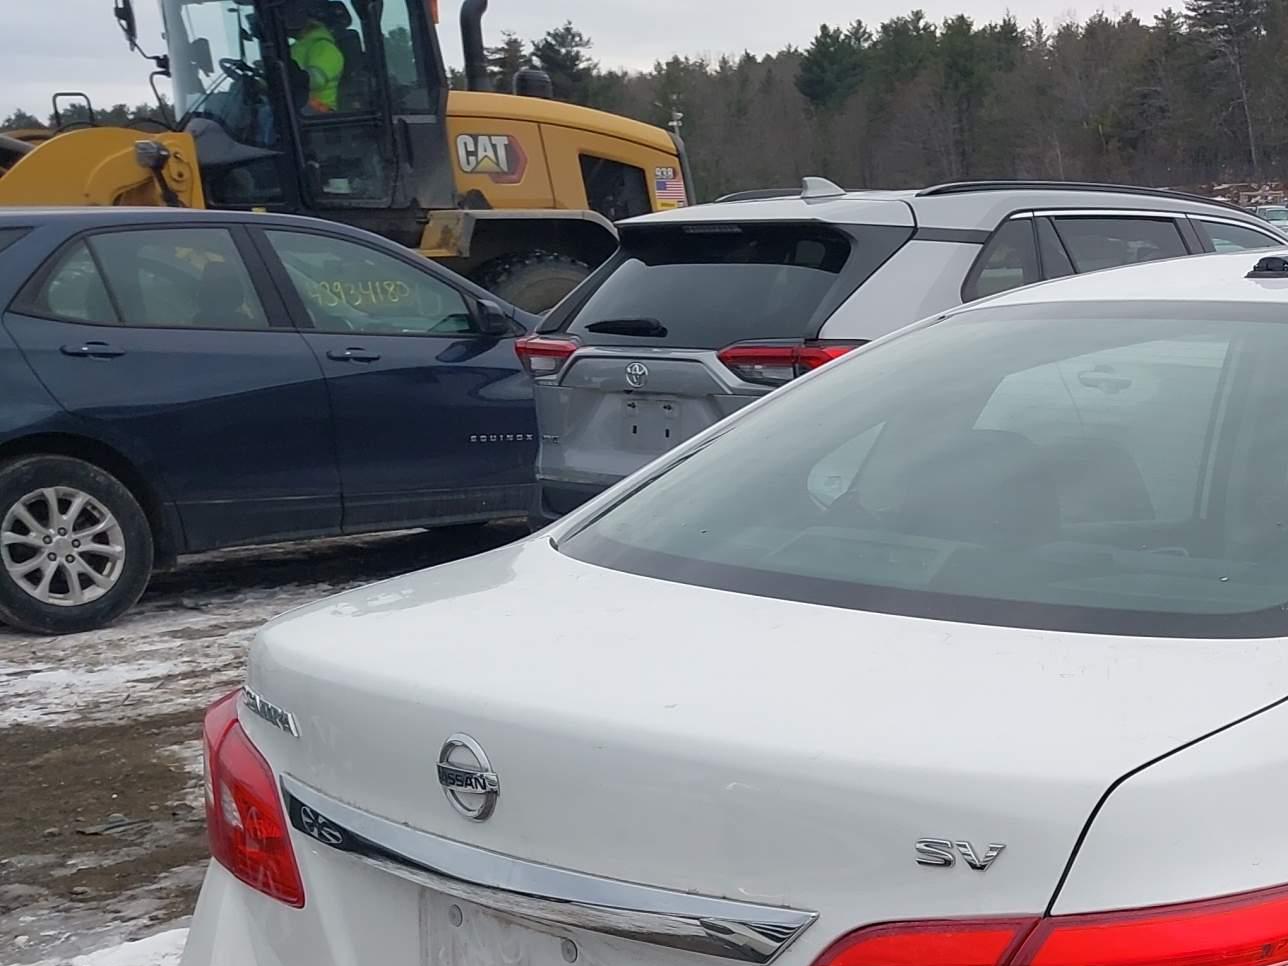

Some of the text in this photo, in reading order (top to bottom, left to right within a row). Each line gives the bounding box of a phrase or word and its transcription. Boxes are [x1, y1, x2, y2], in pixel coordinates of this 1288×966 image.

[456, 134, 509, 174] CAT
[470, 433, 534, 443] EQUINOX
[915, 837, 1006, 872] SV
